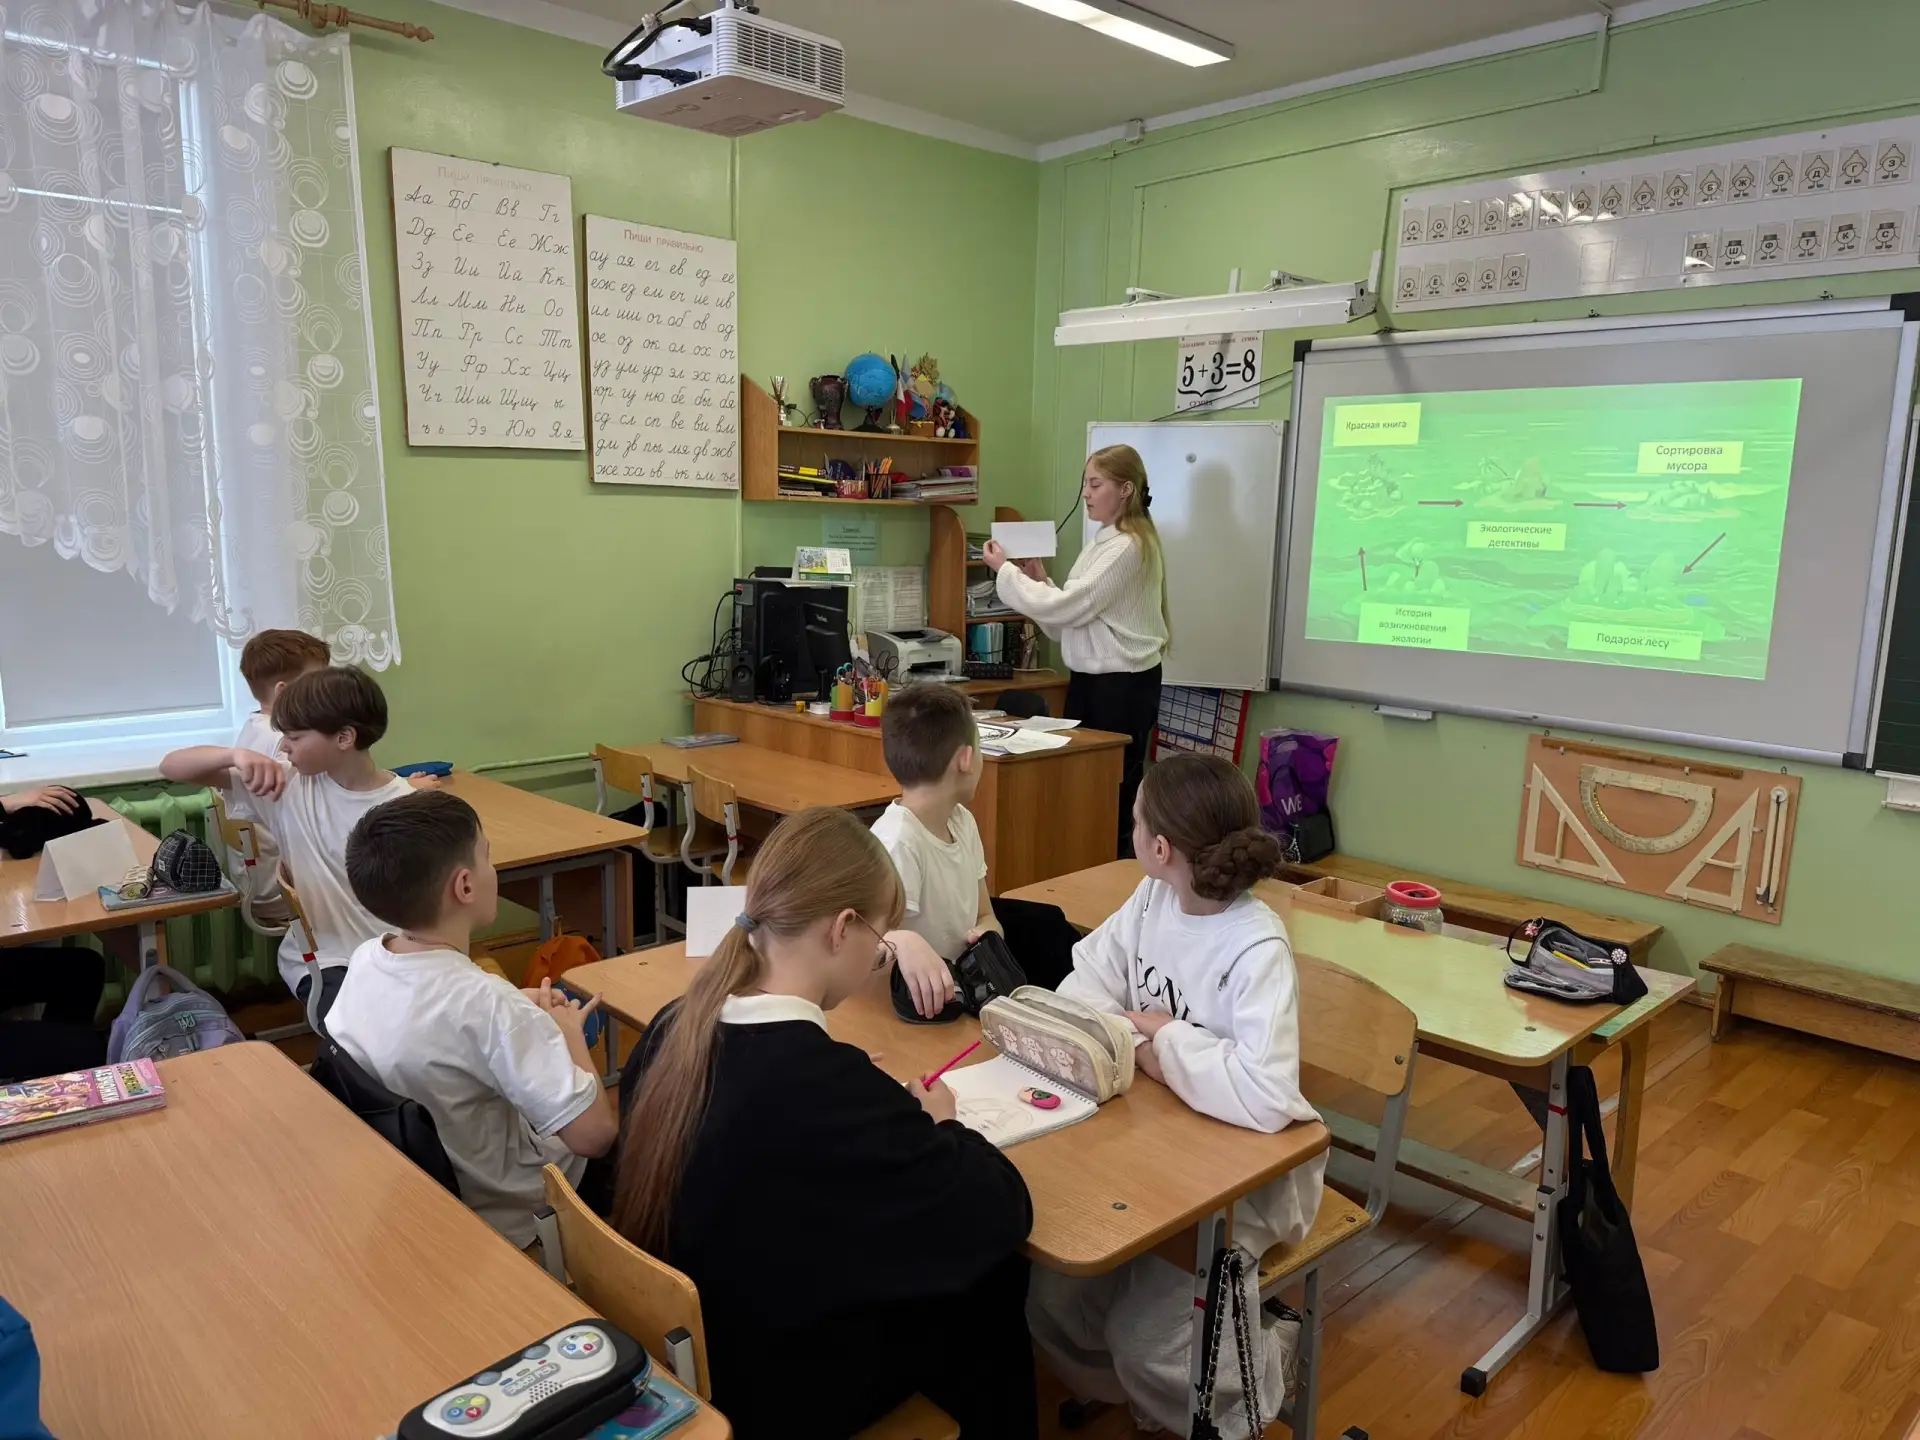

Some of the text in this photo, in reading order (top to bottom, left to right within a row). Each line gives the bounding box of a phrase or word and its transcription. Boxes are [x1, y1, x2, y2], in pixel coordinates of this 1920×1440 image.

[623, 229, 652, 244] Пиши
[1182, 349, 1256, 387] 5+3=8
[1345, 421, 1380, 431] Красная
[1656, 445, 1723, 456] Сортировка
[1666, 462, 1708, 472] мусора
[1479, 523, 1552, 534] Экологические
[1488, 539, 1540, 548] детективы
[1395, 608, 1432, 618] История
[1379, 621, 1447, 632] возникновения
[1391, 635, 1432, 645] экологии
[1596, 632, 1643, 646] Подарок
[1644, 638, 1670, 650] лесу
